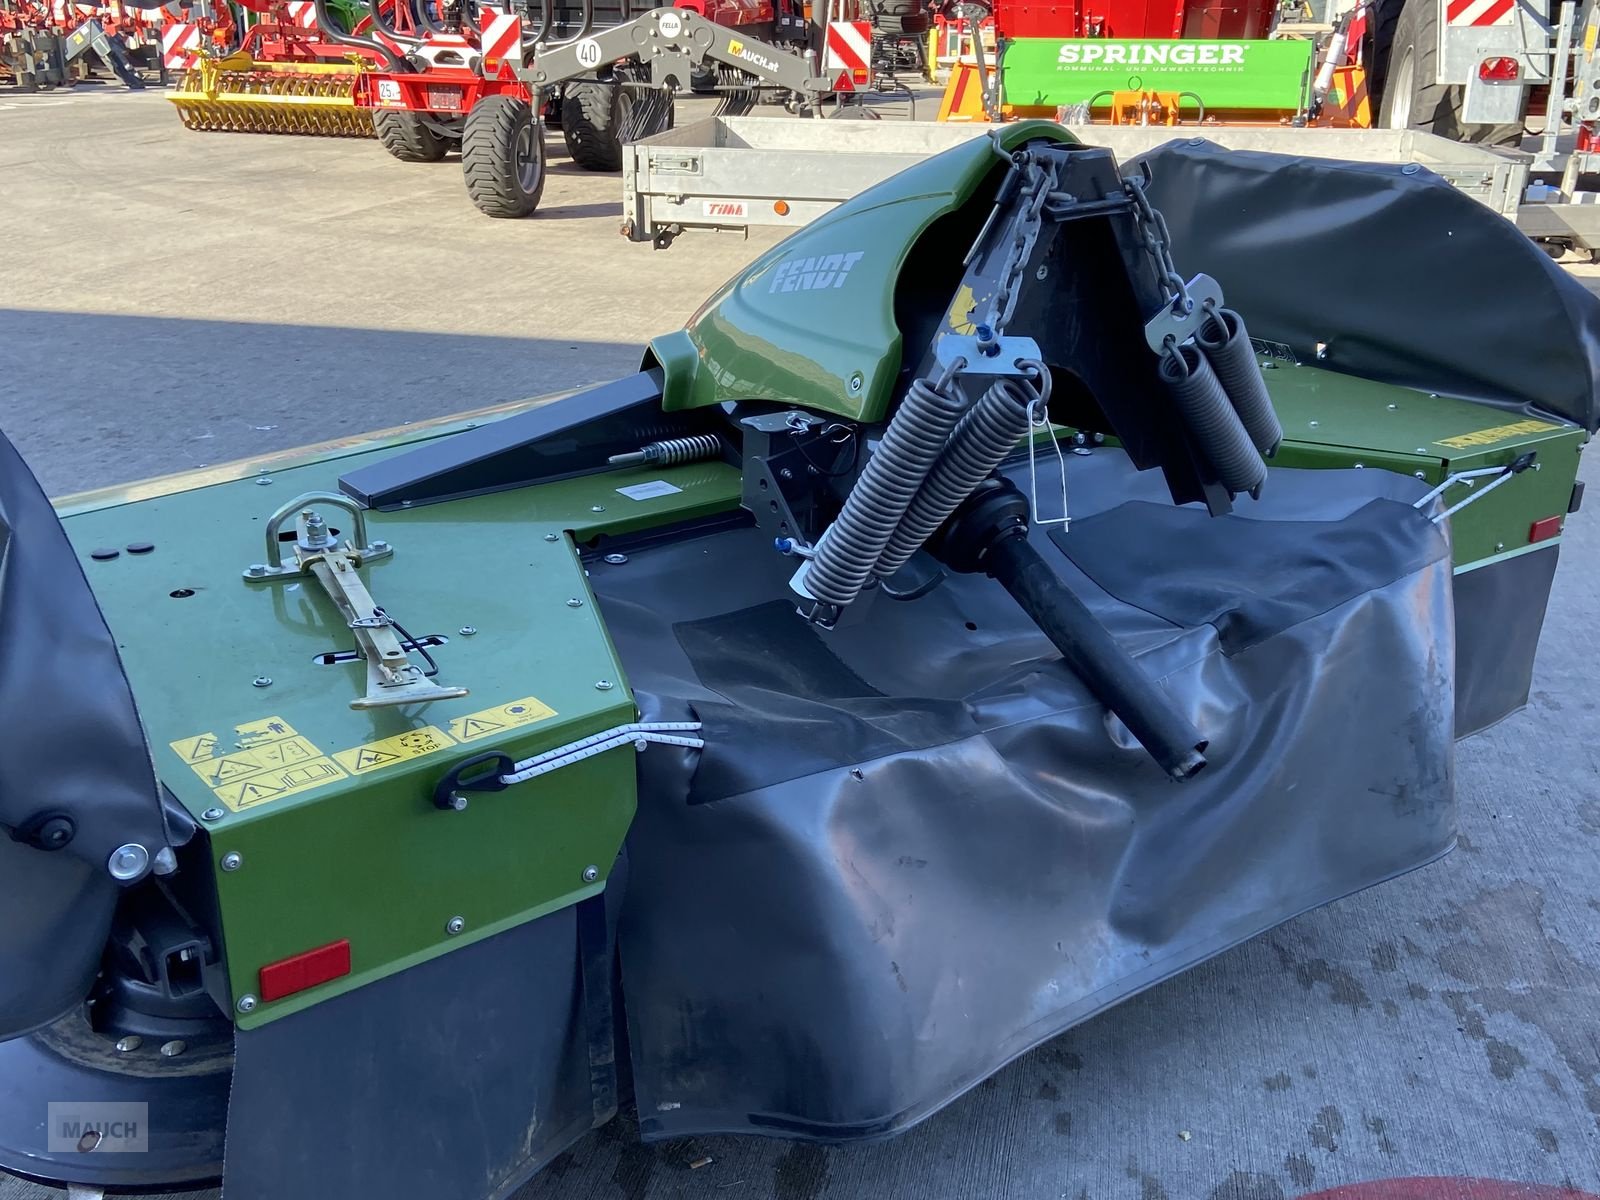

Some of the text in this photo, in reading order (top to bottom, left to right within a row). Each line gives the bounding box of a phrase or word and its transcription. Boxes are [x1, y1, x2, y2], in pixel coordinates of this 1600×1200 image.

[581, 44, 597, 63] 40
[731, 45, 780, 73] MAUCH.at
[380, 83, 392, 98] 25
[768, 251, 865, 294] FENDT
[412, 743, 441, 755] STOP
